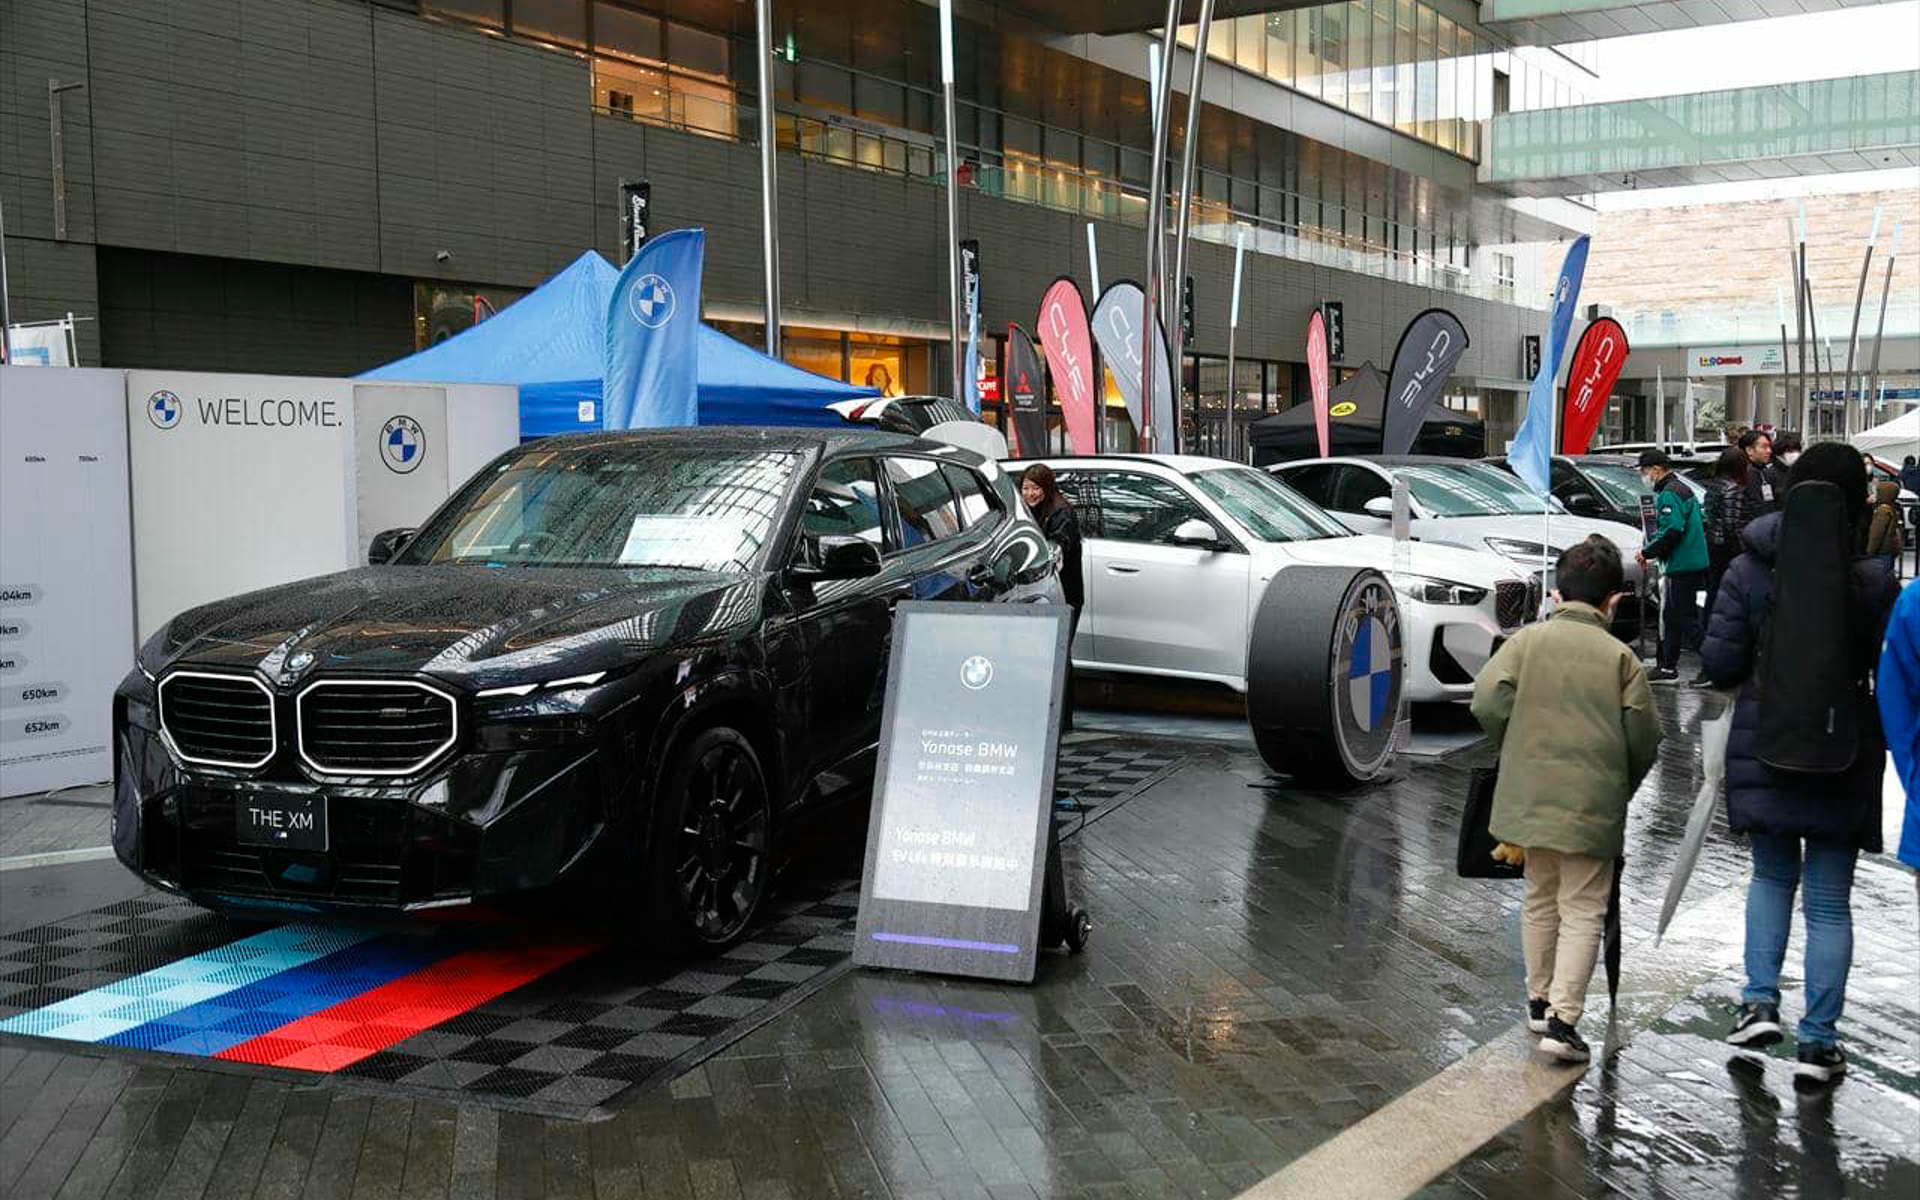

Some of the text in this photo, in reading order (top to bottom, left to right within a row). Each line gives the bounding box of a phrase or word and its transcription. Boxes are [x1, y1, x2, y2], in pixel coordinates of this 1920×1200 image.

[198, 398, 343, 427] WELCOME.
[0, 590, 32, 601] 04km
[22, 689, 58, 700] 650km
[25, 721, 60, 733] 652km
[921, 739, 1018, 758] Yanase BMW
[249, 807, 313, 830] THE XM
[942, 829, 976, 848] BMW
